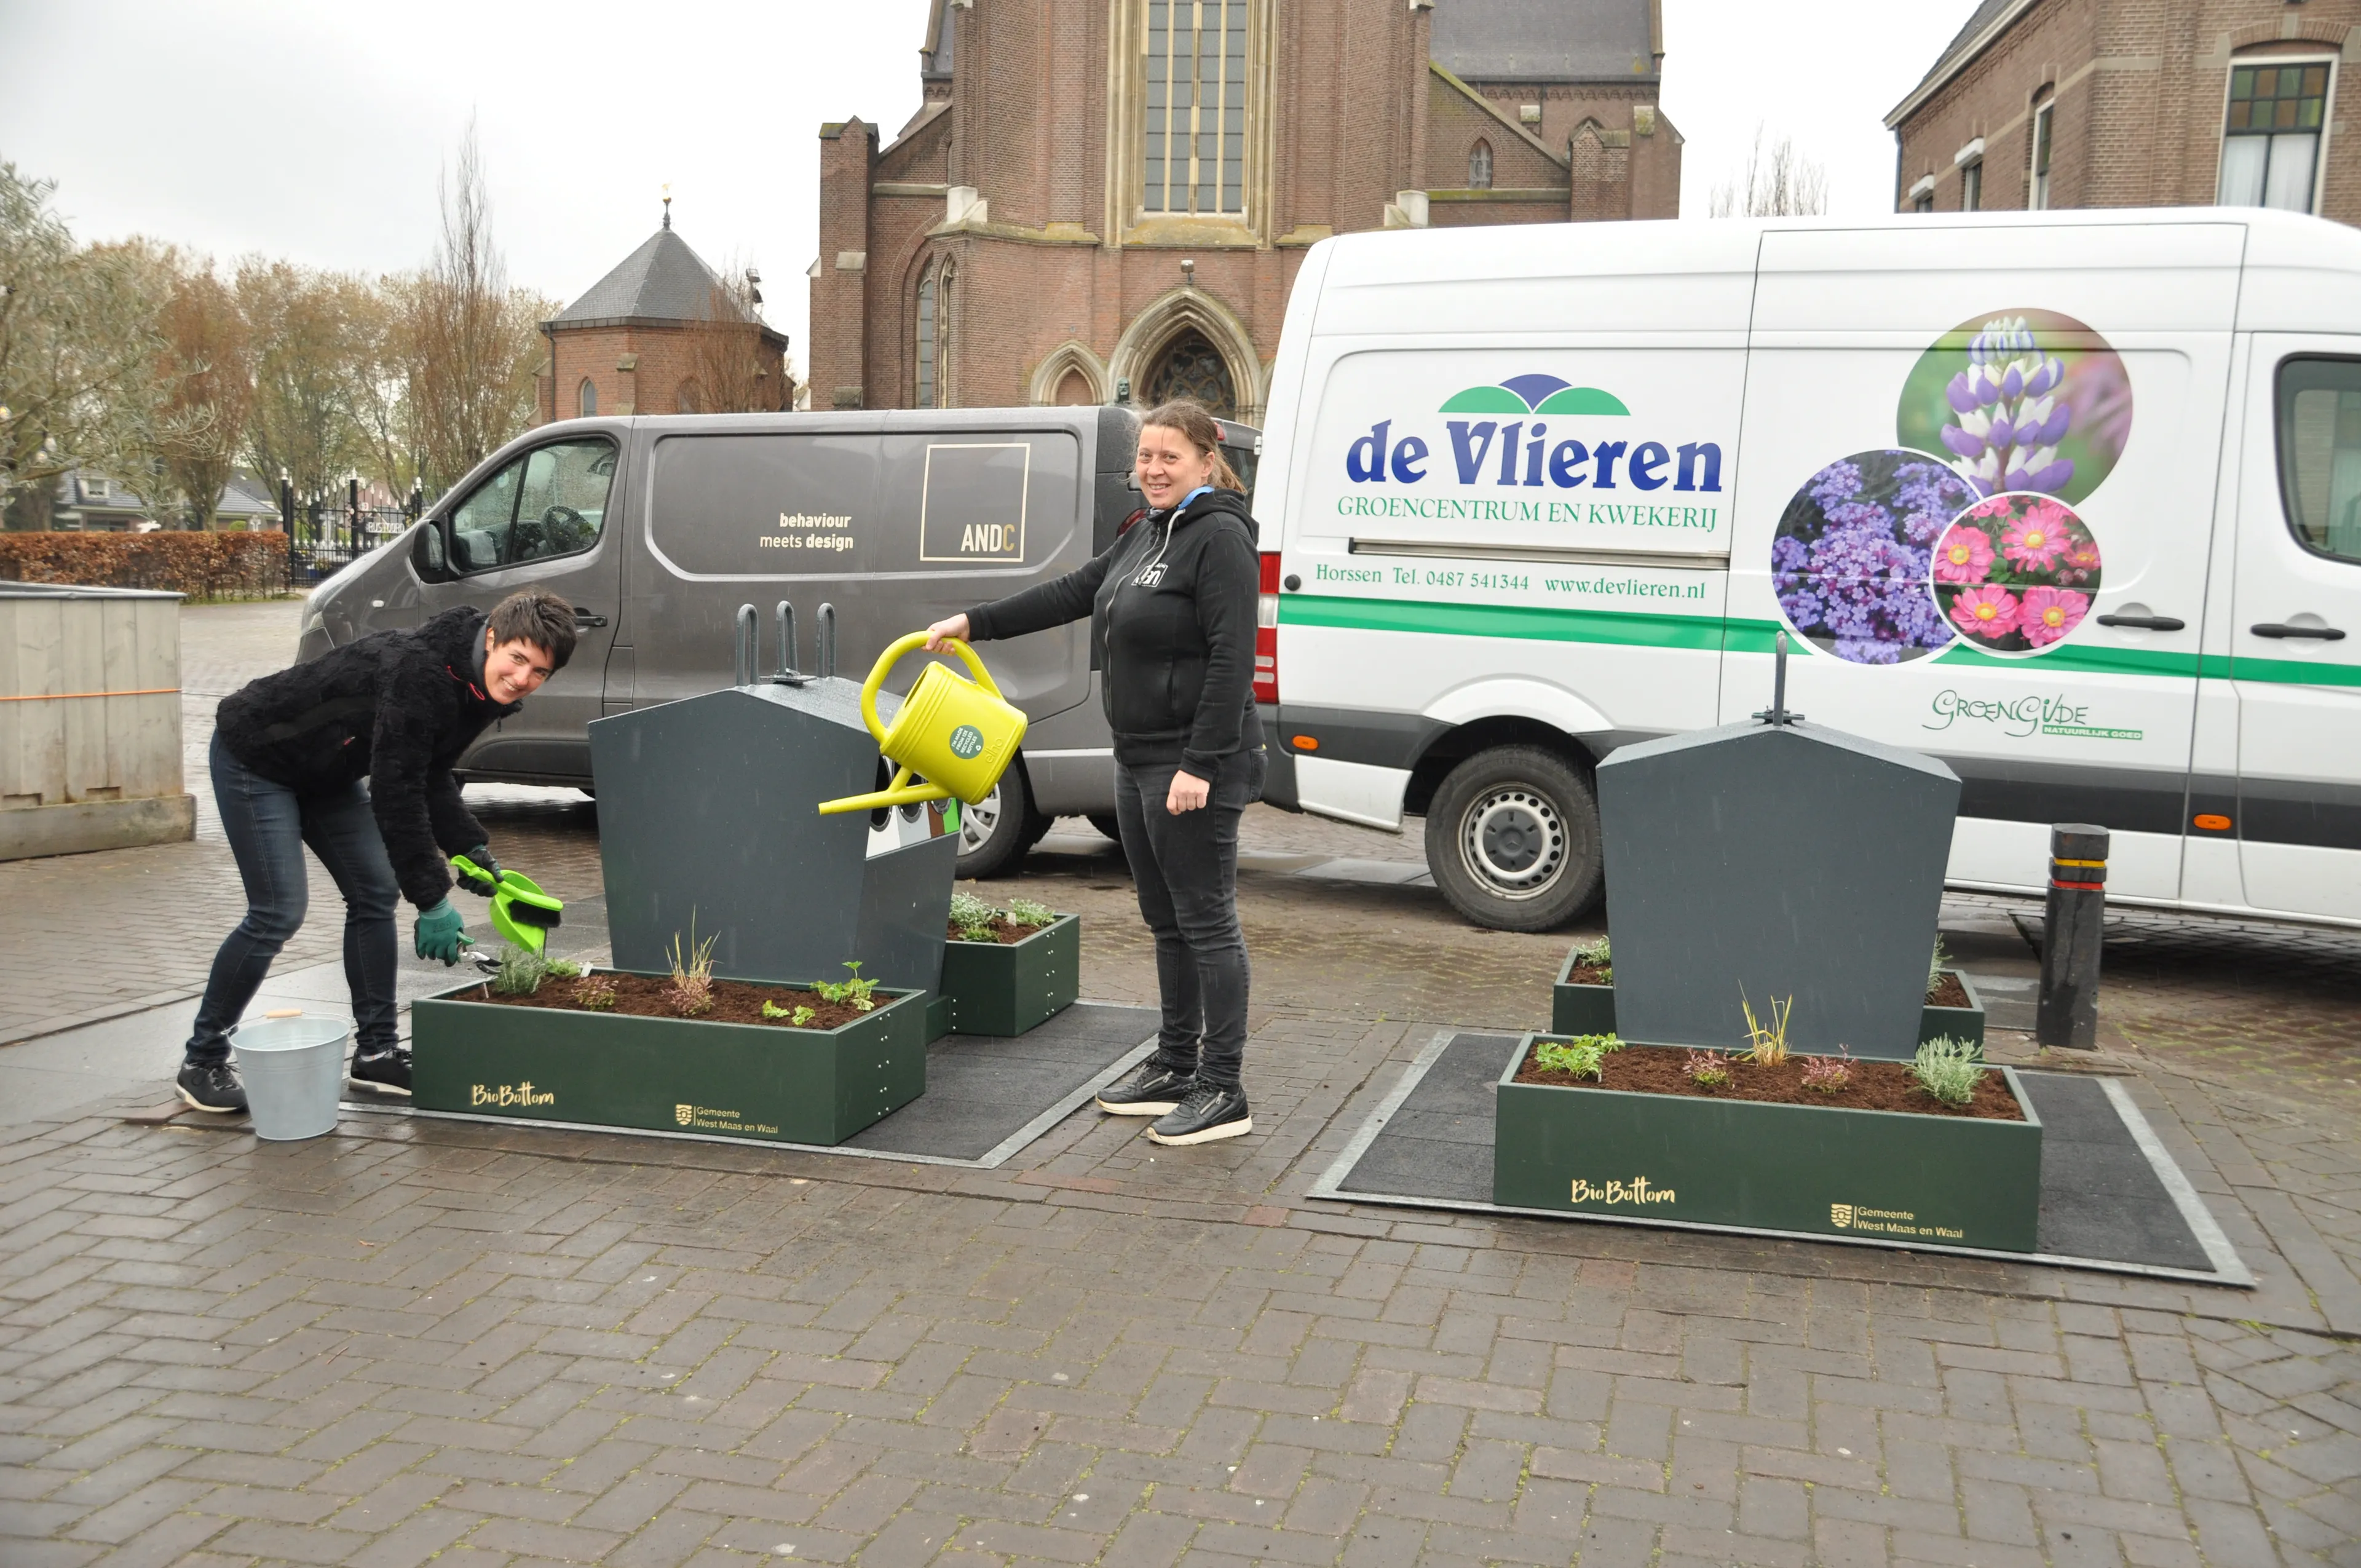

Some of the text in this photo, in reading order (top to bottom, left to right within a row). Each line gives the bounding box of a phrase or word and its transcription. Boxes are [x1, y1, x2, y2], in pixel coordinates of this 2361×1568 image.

[1347, 419, 1722, 492] de Vlieren
[780, 512, 852, 528] behaviour
[1337, 496, 1717, 533] GROENCENTRUM EN KWEKERIJ
[760, 533, 853, 552] meets design
[960, 524, 1015, 552] ANDC
[1316, 564, 1706, 599] Horssen Tel. 0487 541344 www.devlieren.nl
[2043, 726, 2142, 739] NATUURLIJK GOED
[955, 737, 965, 751] FROM
[966, 736, 978, 754] BOTTLES
[985, 738, 1003, 763] elho
[472, 1080, 554, 1106] BioBottom
[697, 1106, 740, 1119] Gemeente
[697, 1119, 718, 1128] West
[719, 1121, 742, 1130] Maas
[757, 1124, 778, 1134] Waal
[1571, 1175, 1675, 1205] BioBottom
[1858, 1206, 1914, 1220] Gemeente
[1857, 1220, 1884, 1232] West
[1887, 1223, 1916, 1234] Maas
[1936, 1227, 1963, 1238] Waal
